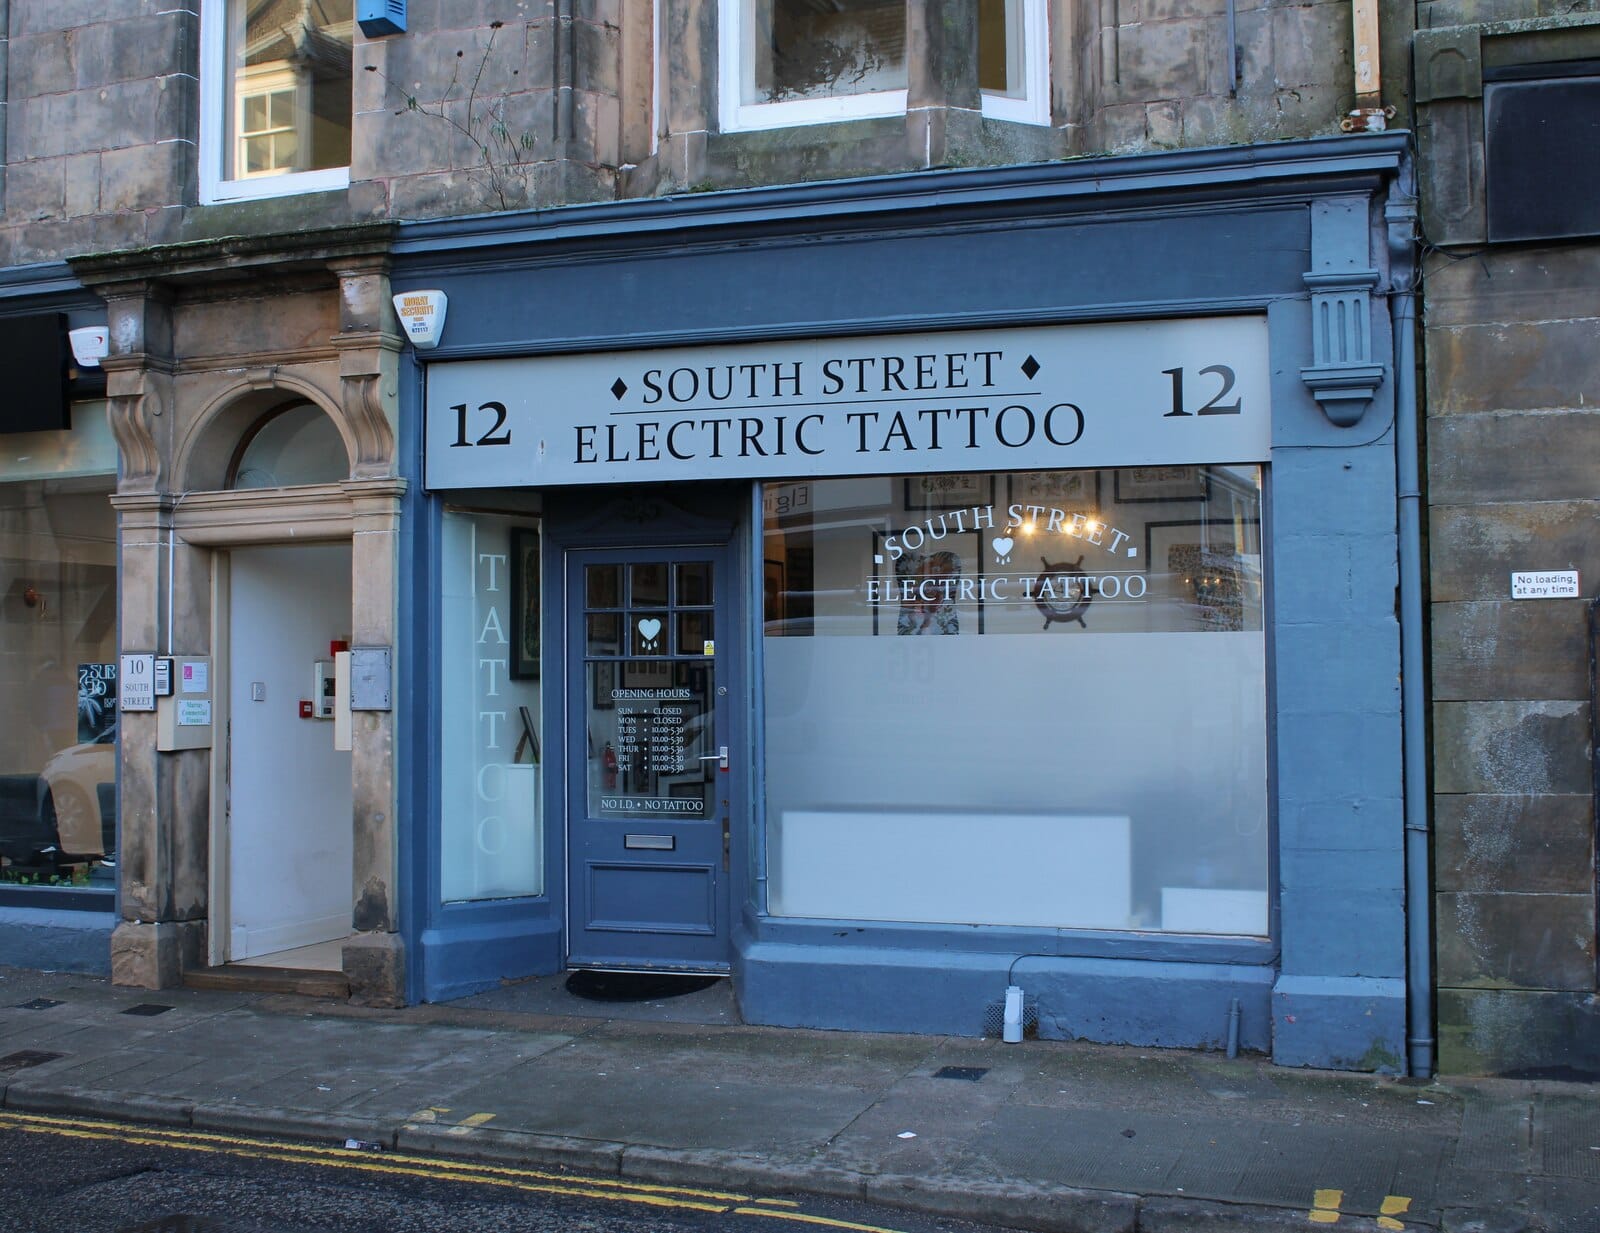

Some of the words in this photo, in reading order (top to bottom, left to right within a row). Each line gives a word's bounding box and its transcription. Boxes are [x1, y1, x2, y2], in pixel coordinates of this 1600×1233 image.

[401, 305, 434, 316] SECURITY
[642, 361, 803, 404] SOUTH
[822, 351, 1003, 395] STREET
[1161, 364, 1242, 417] 12
[449, 401, 511, 448] 12
[573, 414, 825, 464] ELECTRIC
[847, 403, 1085, 453] TATTOO
[884, 505, 995, 561] SOUTH
[1007, 504, 1130, 555] STREET
[1517, 576, 1532, 584] No
[1535, 575, 1573, 585] loading
[866, 577, 1009, 602] ELECTRIC
[1019, 574, 1148, 600] TATTOO
[1530, 587, 1548, 595] any
[1552, 586, 1574, 594] time
[130, 660, 144, 674] 10
[125, 682, 149, 692] SOUTH
[611, 689, 654, 698] OPENING
[656, 689, 690, 698] HOURS
[123, 697, 151, 706] STREET
[602, 800, 616, 808] NO
[620, 800, 634, 808] I.D.
[644, 800, 660, 810] NO
[662, 800, 704, 810] TATTOO
